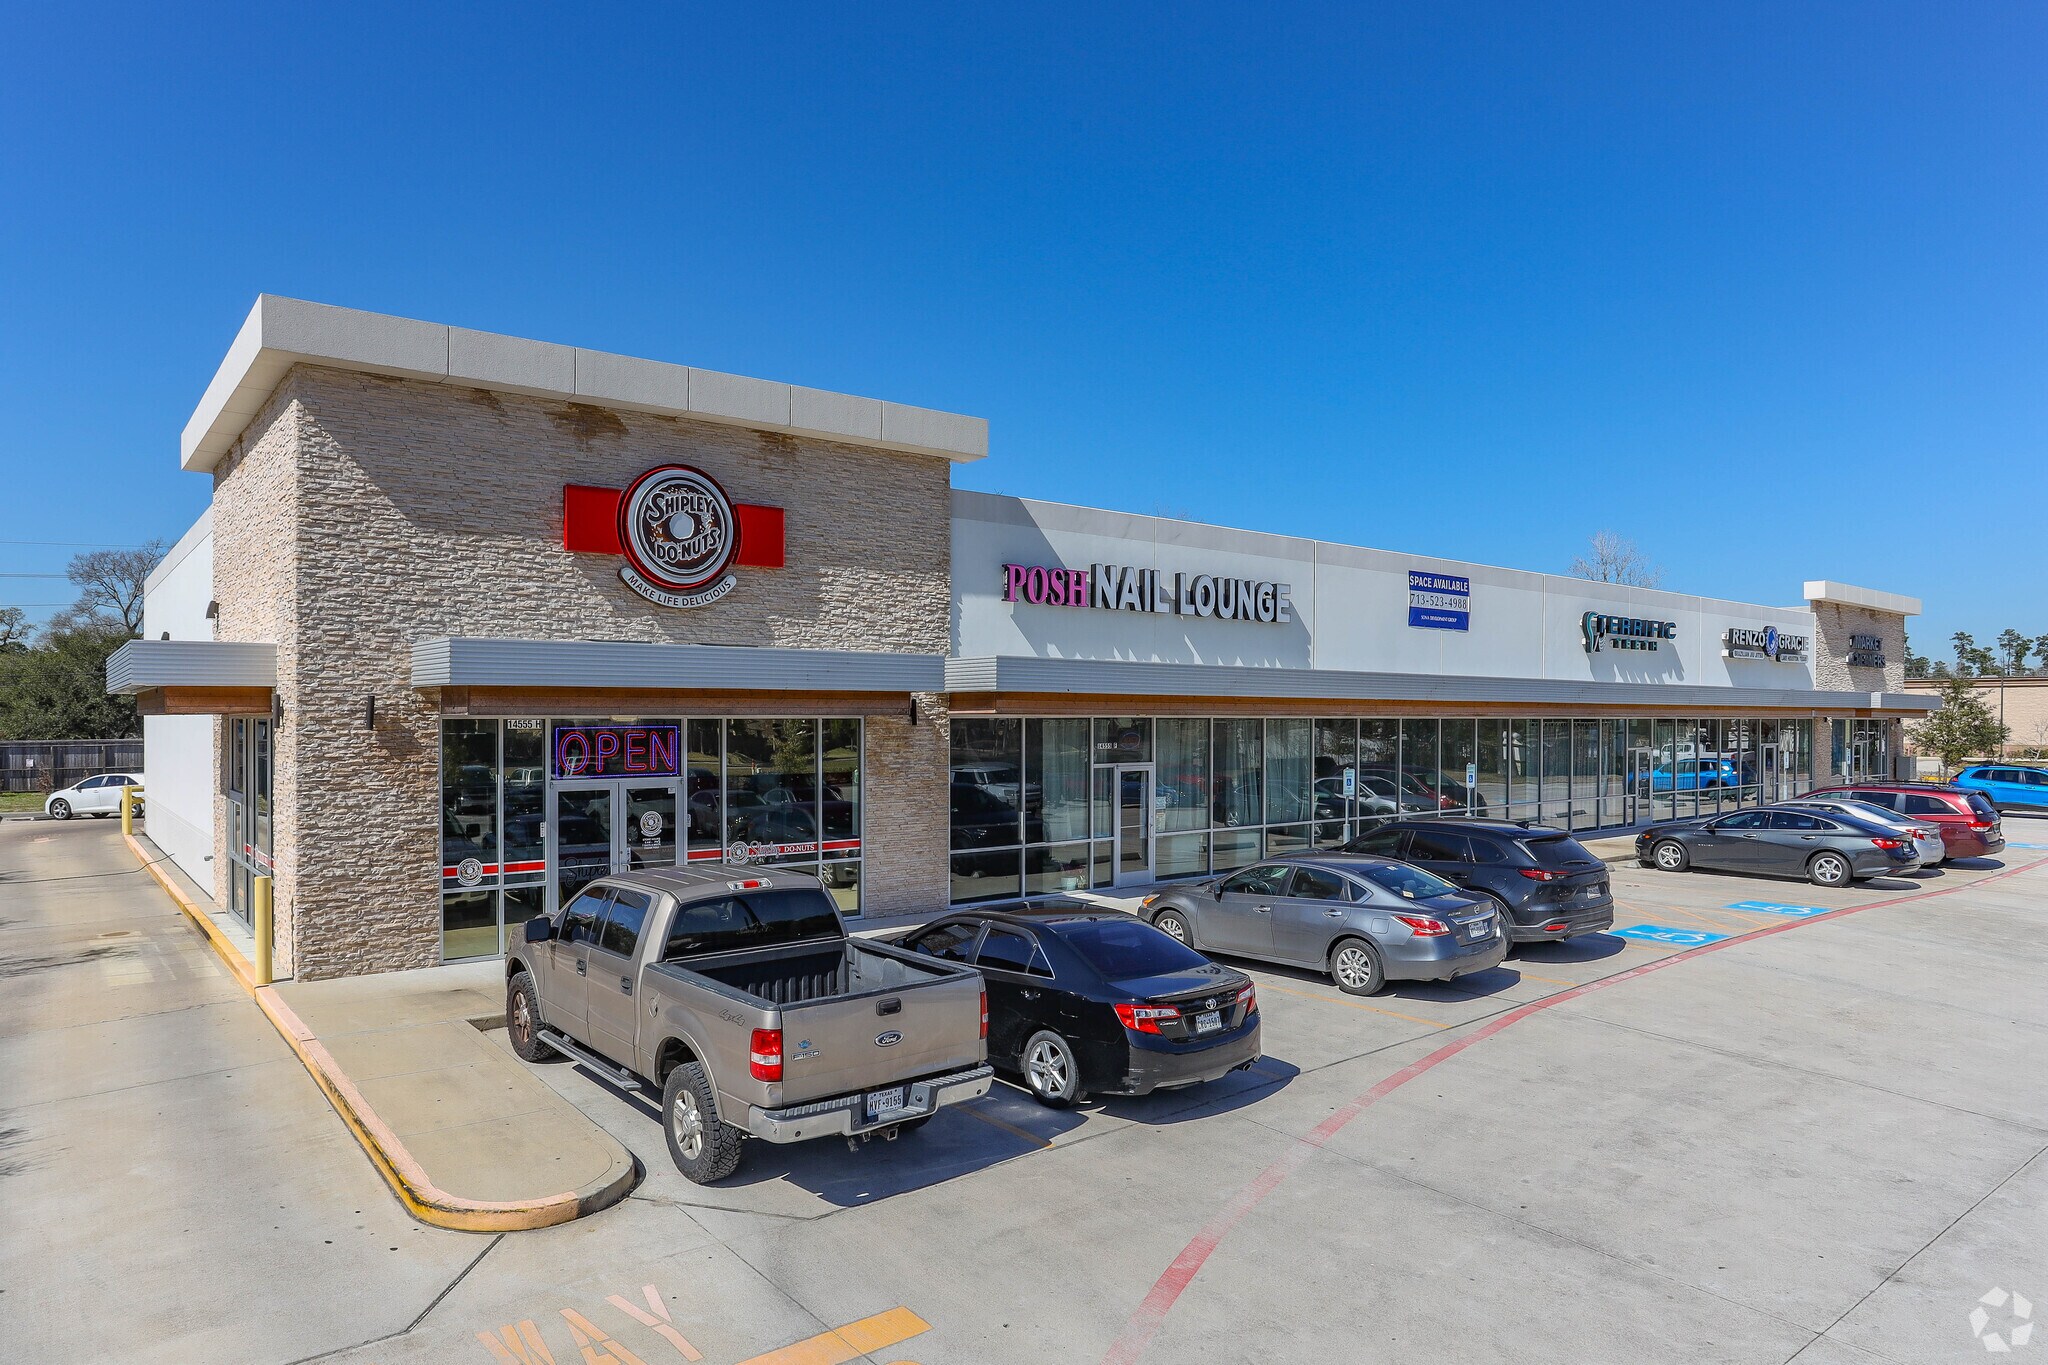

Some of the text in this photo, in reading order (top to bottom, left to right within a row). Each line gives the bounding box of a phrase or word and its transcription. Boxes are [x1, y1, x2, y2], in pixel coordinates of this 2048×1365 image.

[646, 492, 714, 522] SHIPLEY
[628, 575, 733, 607] MAKE LIFE DELICIOUS
[1001, 563, 1291, 623] POSH NAIL LOUNGE
[1409, 575, 1468, 592] SPACE AVAILABLE
[1410, 593, 1467, 610] 713-523-4988
[1597, 614, 1677, 640] TERRIFIC
[1731, 628, 1809, 651] RENZO GRACIE
[508, 719, 533, 729] 14555
[559, 731, 675, 774] OPEN
[784, 844, 815, 853] DO-NUTS
[879, 1090, 893, 1098] TEXAS
